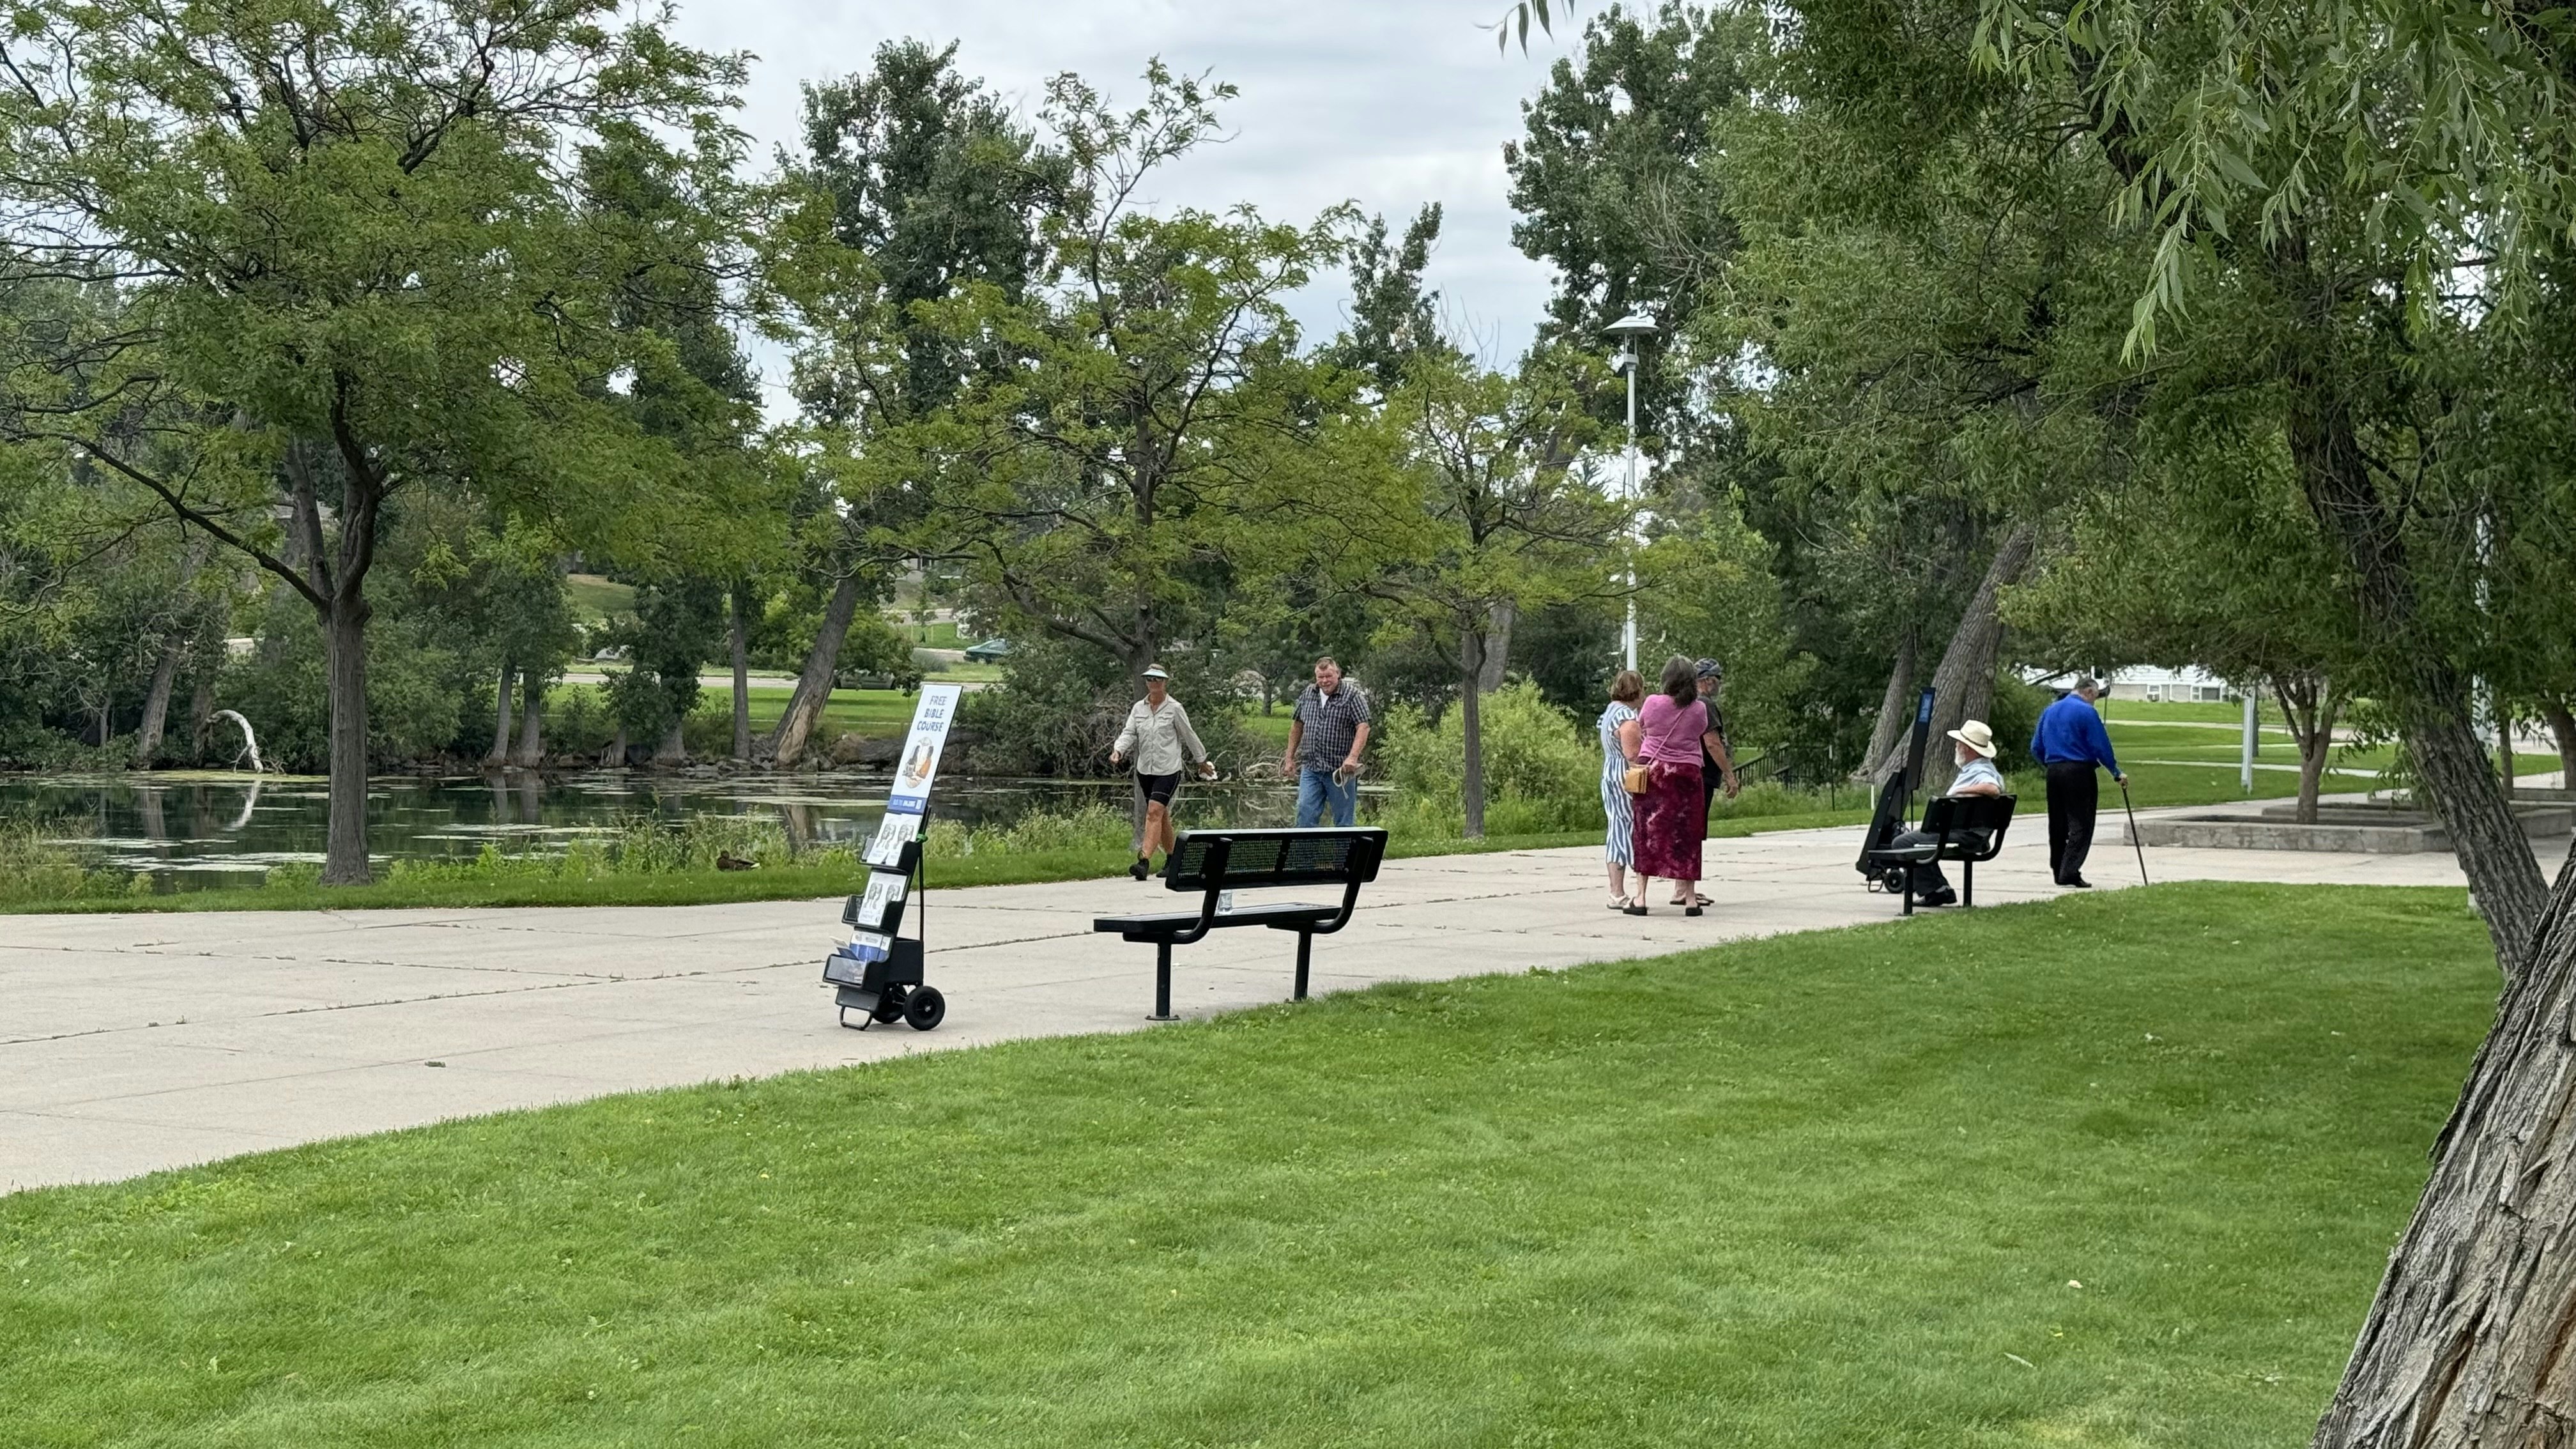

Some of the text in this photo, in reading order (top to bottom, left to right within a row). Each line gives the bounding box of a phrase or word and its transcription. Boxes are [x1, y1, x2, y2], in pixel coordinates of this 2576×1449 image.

[930, 696, 947, 705] FREE
[924, 709, 944, 718] BIBLE
[917, 721, 944, 732] COURSE
